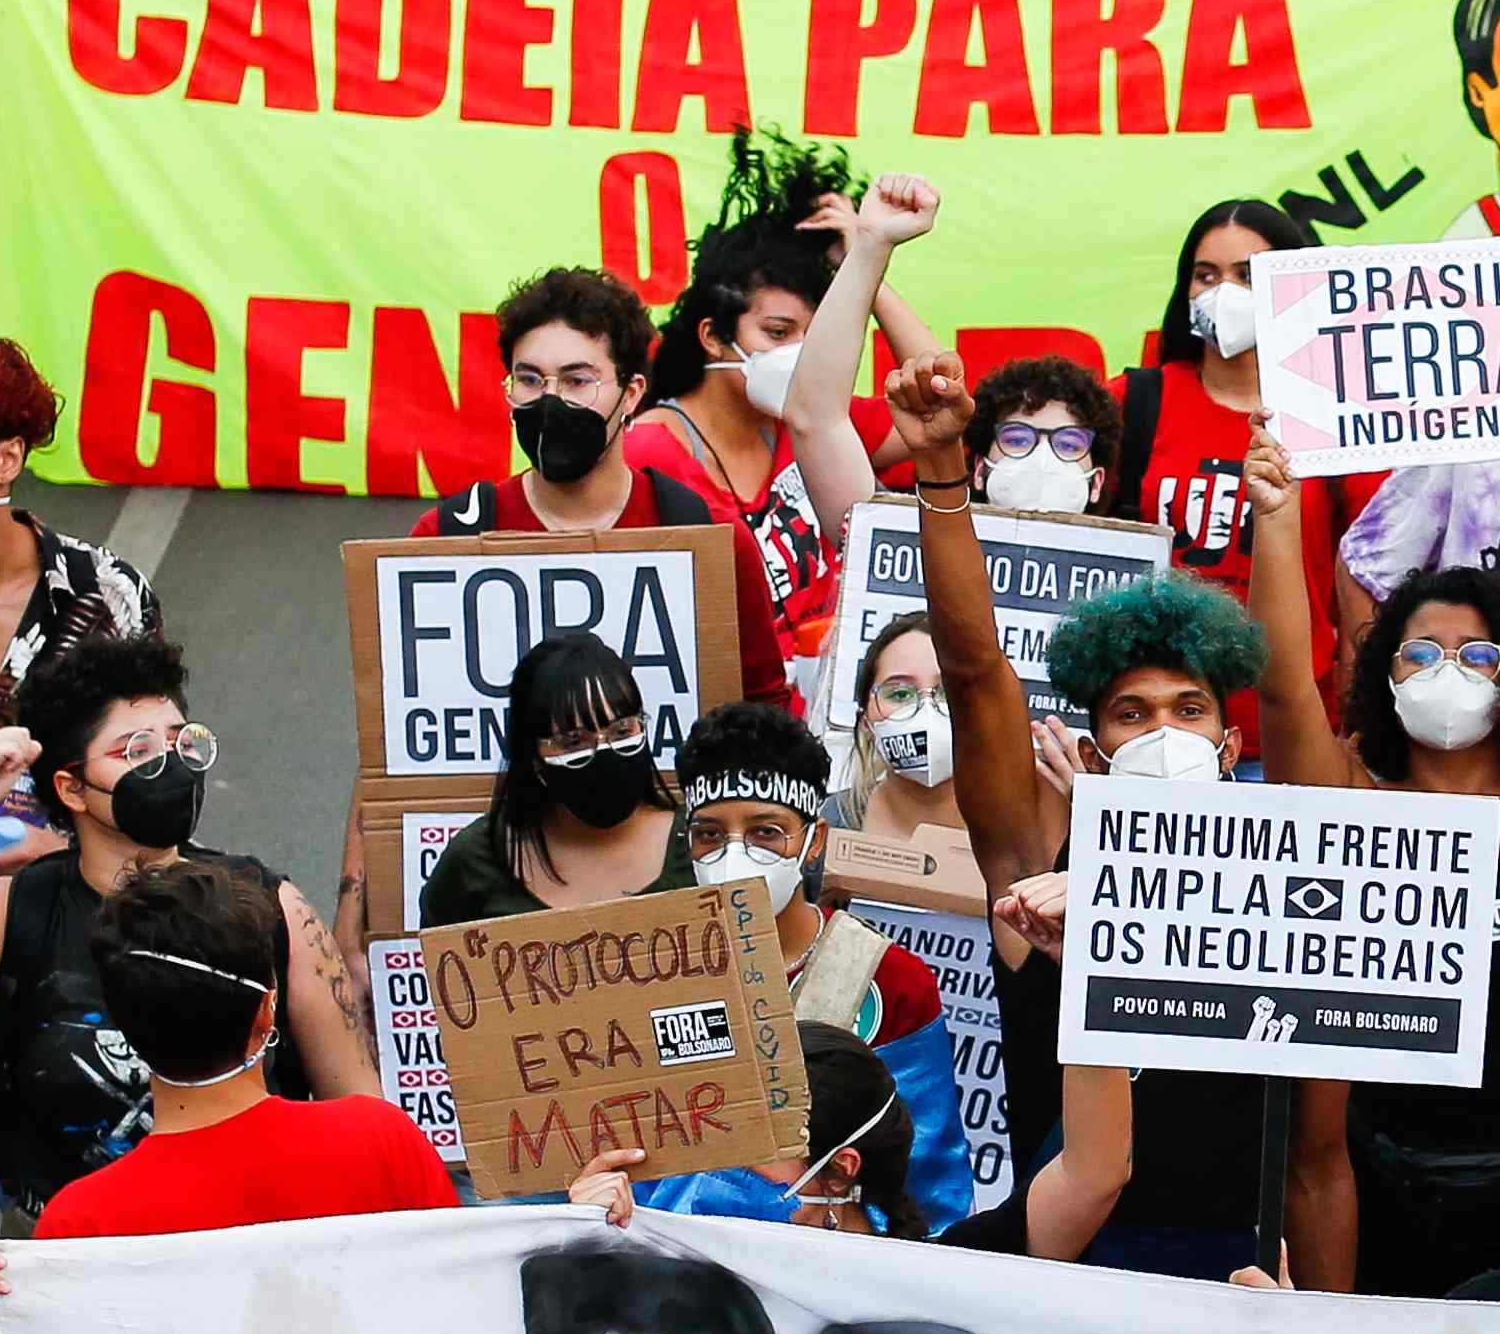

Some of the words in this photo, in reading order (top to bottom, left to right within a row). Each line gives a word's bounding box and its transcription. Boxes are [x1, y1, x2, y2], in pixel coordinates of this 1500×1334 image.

[599, 147, 689, 307] O
[1277, 149, 1426, 245] NL
[1019, 559, 1059, 601] DA
[880, 733, 918, 759] FORA
[1097, 808, 1299, 864] NENHUMA
[1317, 822, 1474, 874] FRENTE
[1090, 864, 1271, 918] AMPLA
[1359, 880, 1469, 930] COM
[1089, 919, 1147, 966] OS
[1164, 923, 1465, 986] NEOLIBERAIS
[654, 1014, 710, 1049] FORA
[1113, 995, 1159, 1017] POVO
[1163, 998, 1188, 1018] NA
[1191, 1001, 1227, 1021] RUA
[1314, 1008, 1352, 1029] FORA
[1355, 1011, 1439, 1035] BOLSONARO
[510, 1017, 644, 1095] ERA
[678, 1033, 732, 1057] BOLSONARO
[751, 998, 791, 1111] COVID
[507, 1081, 733, 1175] MATAR
